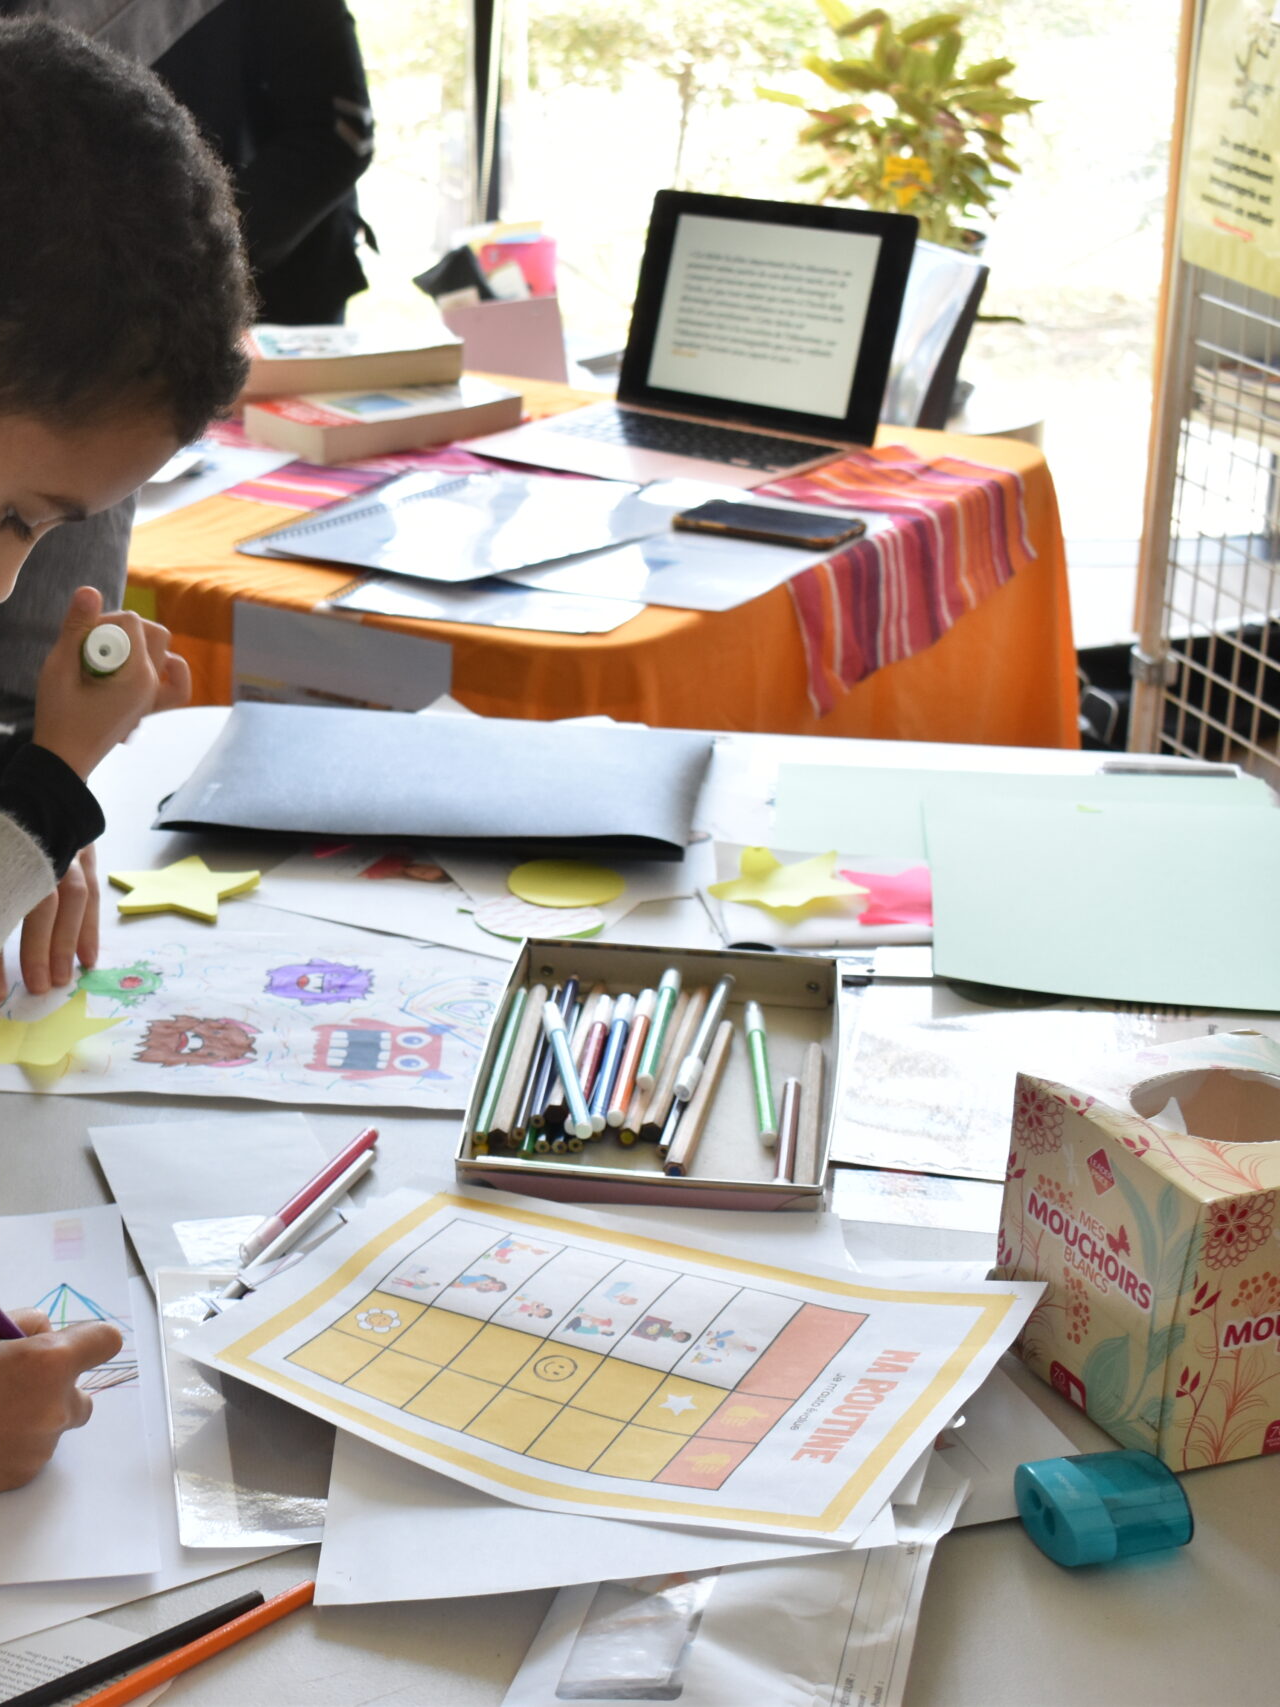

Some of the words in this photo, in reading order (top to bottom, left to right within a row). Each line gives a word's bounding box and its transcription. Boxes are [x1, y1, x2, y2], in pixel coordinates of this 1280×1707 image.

[1027, 1192, 1153, 1310] MOUCHOIRS
[1079, 1211, 1106, 1242] MES
[1063, 1245, 1110, 1295] BLANCS
[791, 1377, 899, 1465] ROUTINE
